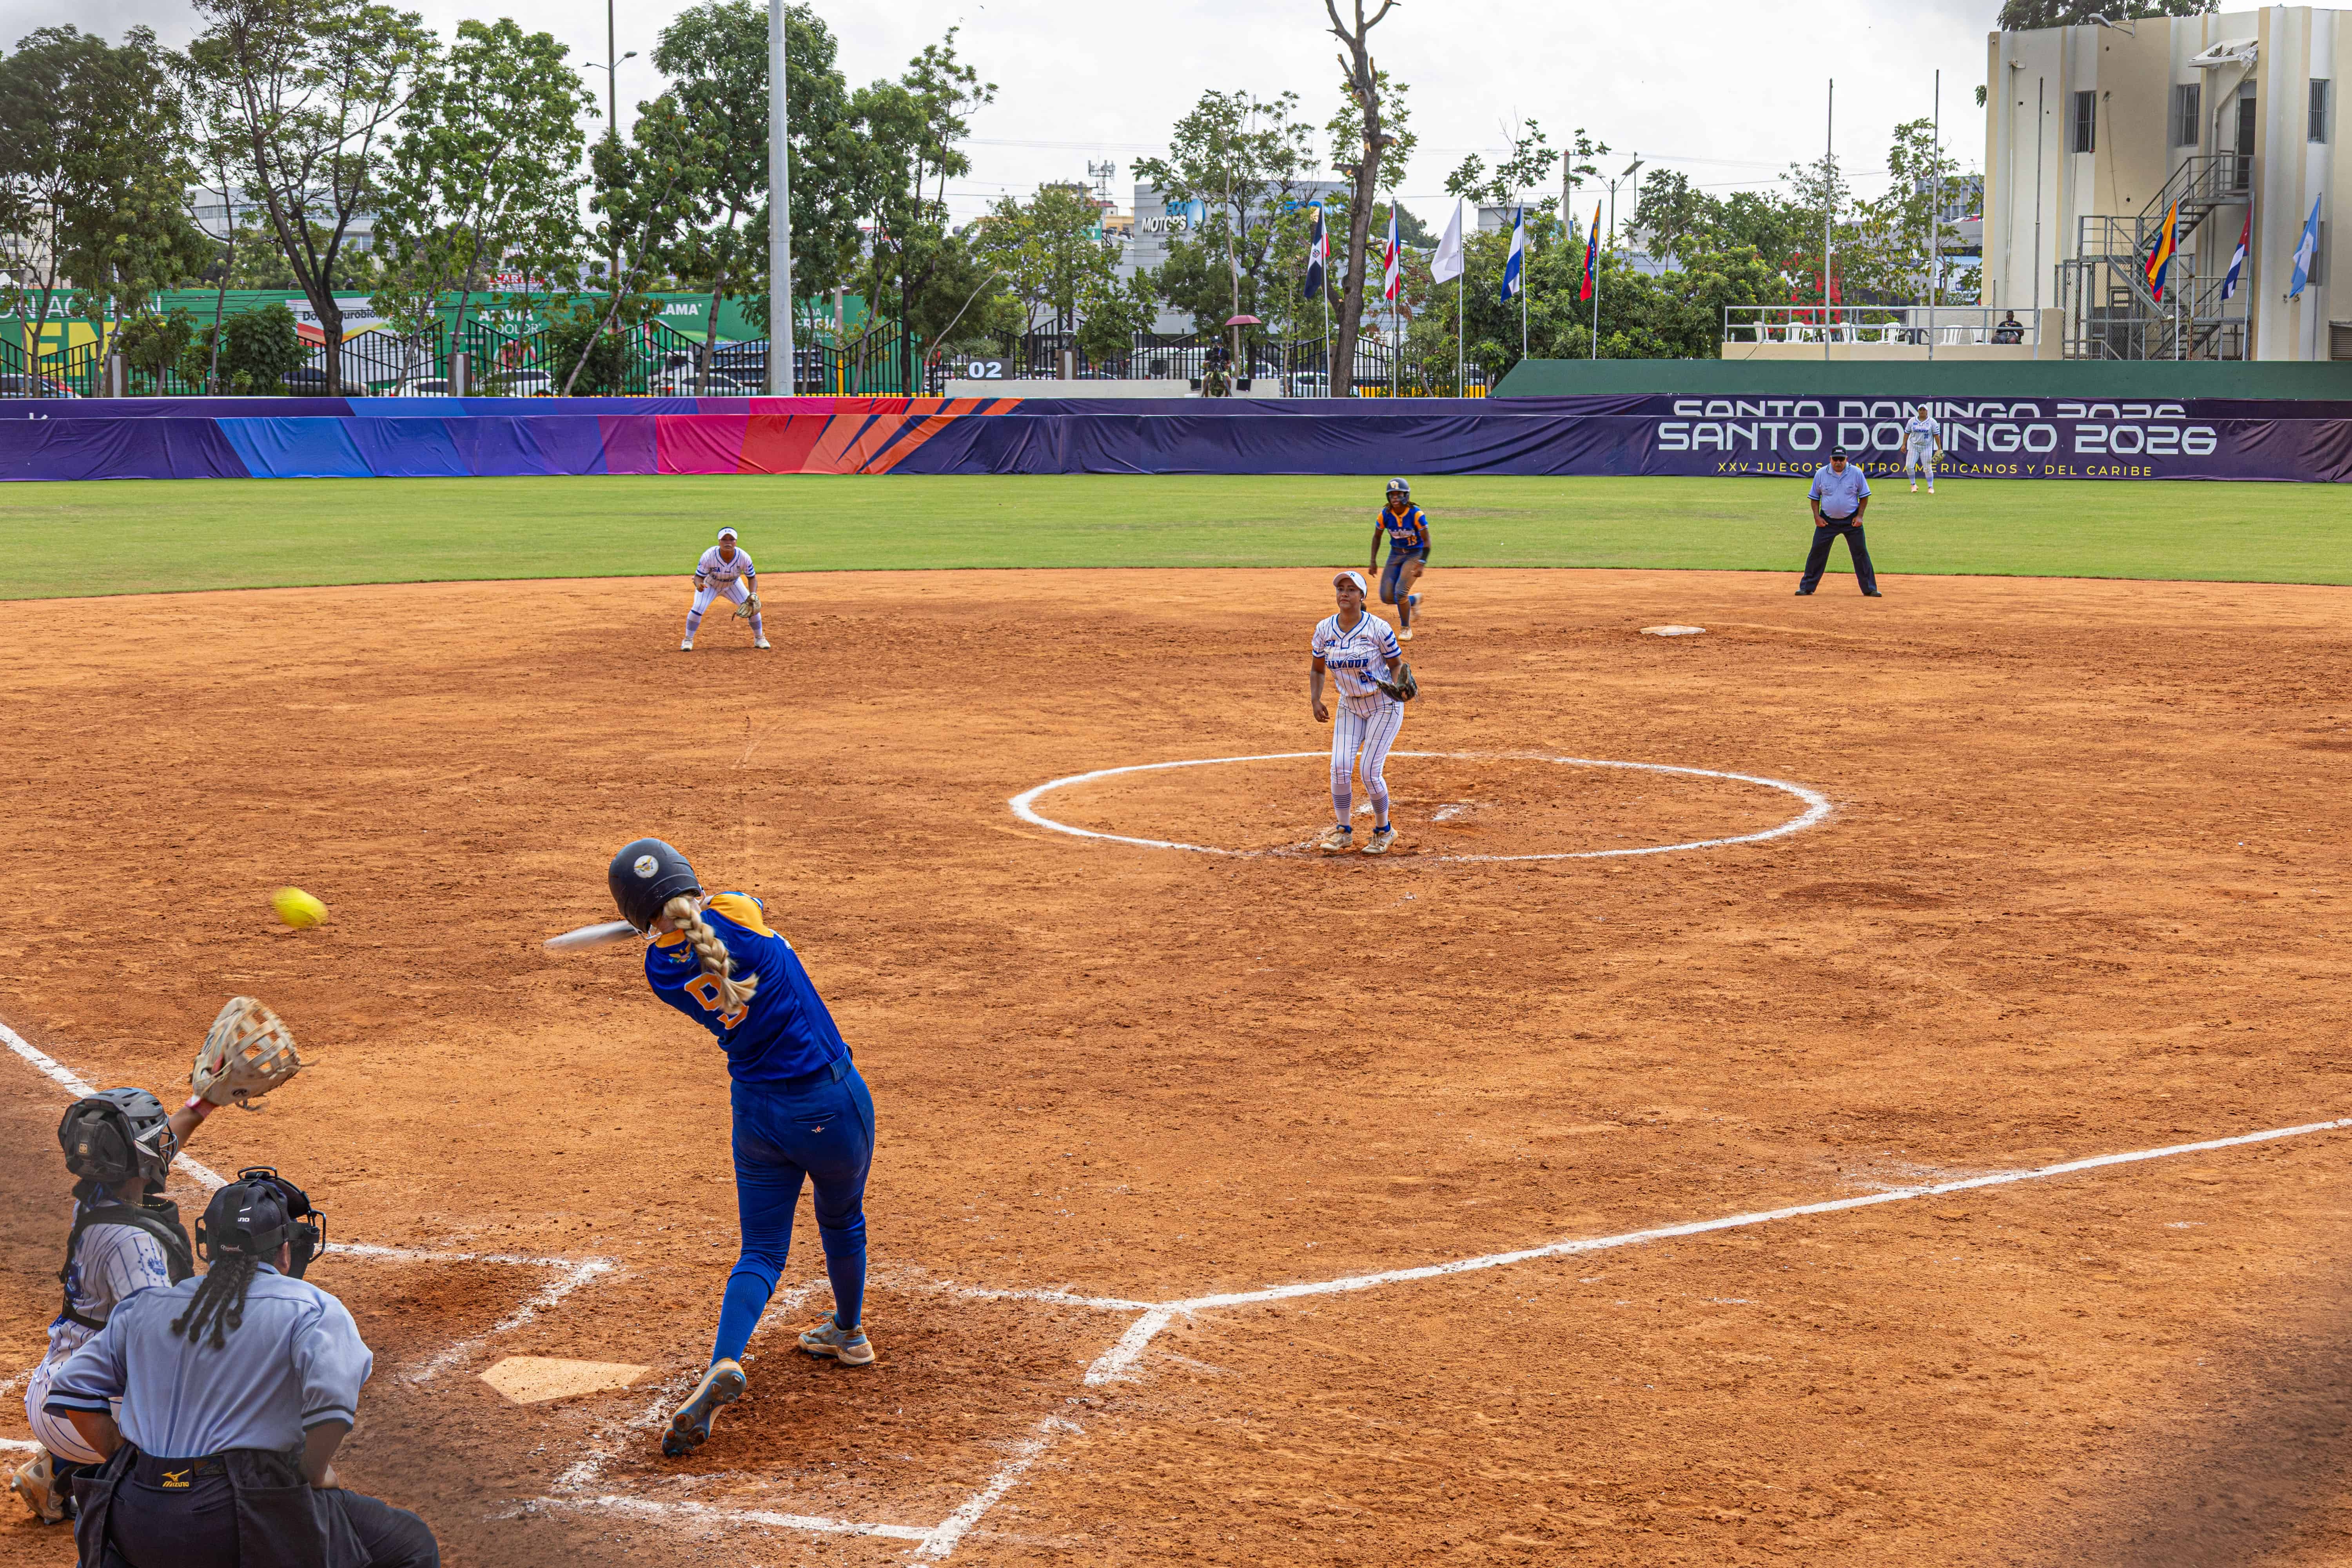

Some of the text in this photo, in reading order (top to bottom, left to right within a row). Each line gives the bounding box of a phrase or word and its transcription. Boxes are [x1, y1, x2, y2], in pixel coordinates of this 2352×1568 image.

[1166, 201, 1188, 215] ECO
[969, 361, 1002, 378] 02
[1674, 401, 1824, 417] SANTO
[2057, 404, 2186, 419] 2026
[1658, 423, 1822, 450] SANTO
[2075, 424, 2217, 455] 2026
[1718, 463, 2152, 476] XXV JUEGOS NTROMERICANOS Y DEL CARIBE
